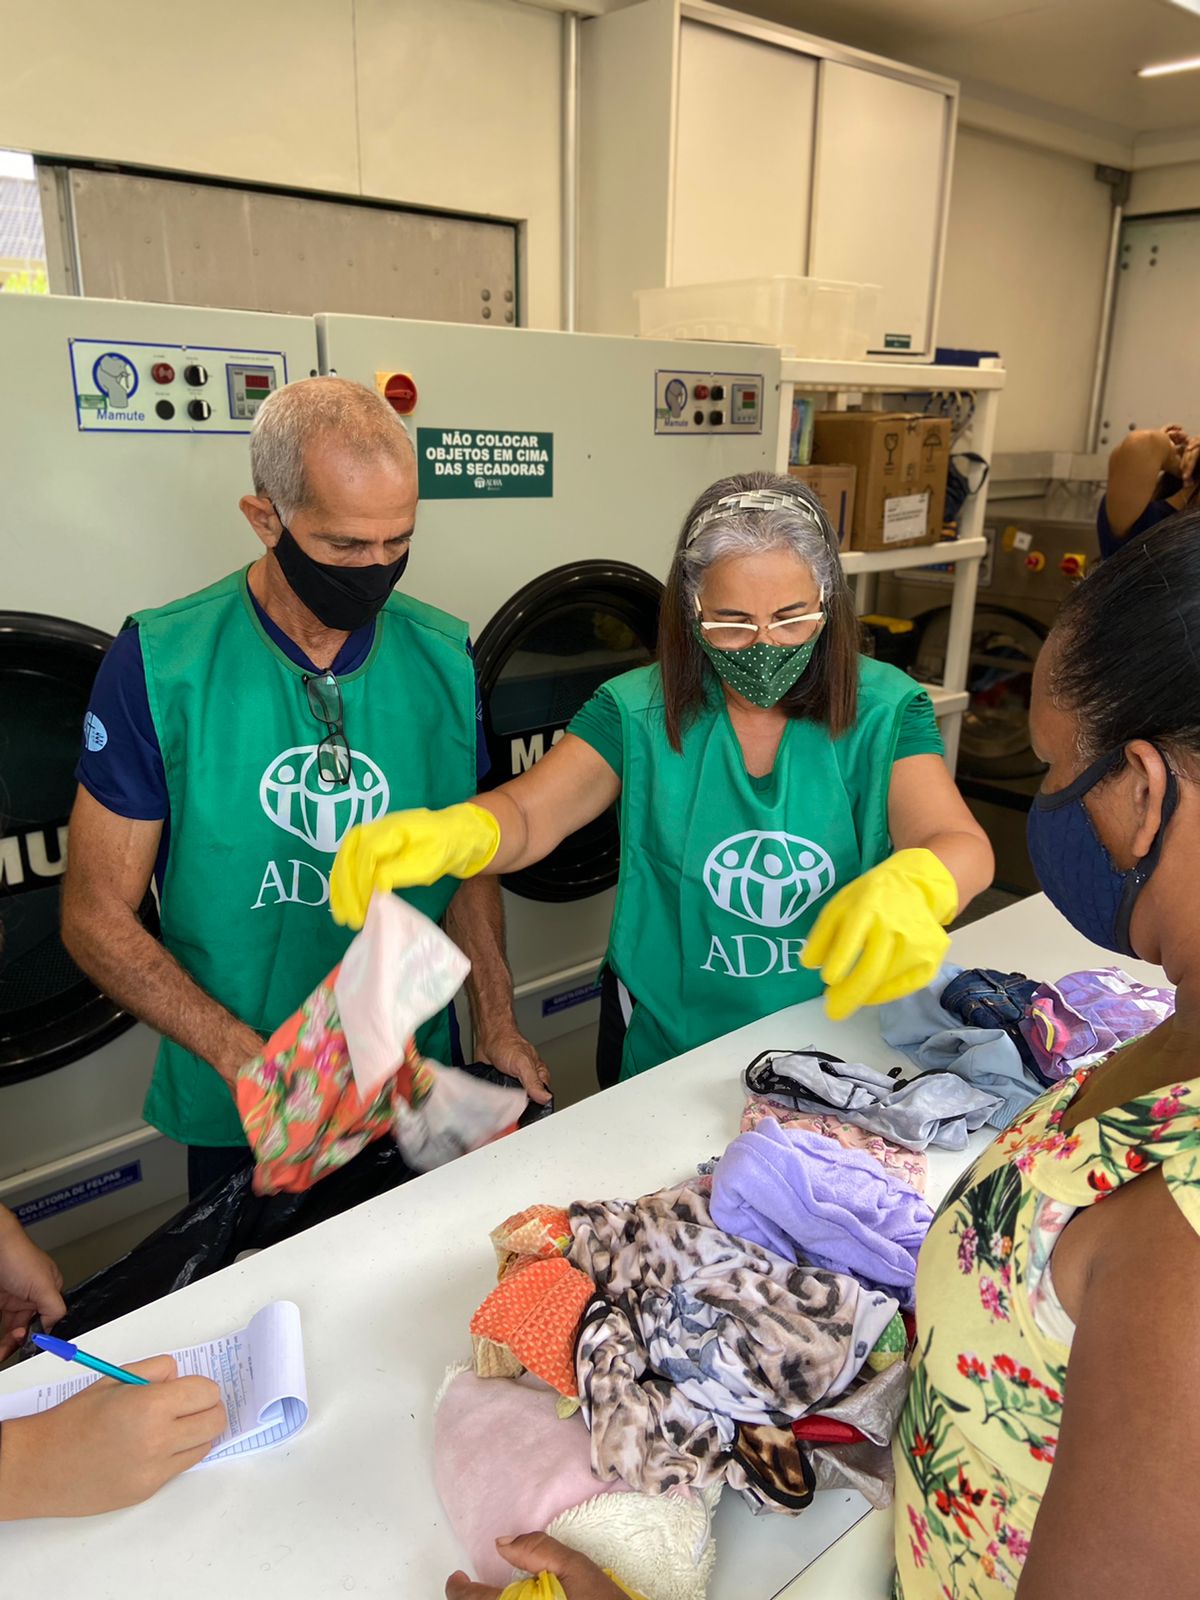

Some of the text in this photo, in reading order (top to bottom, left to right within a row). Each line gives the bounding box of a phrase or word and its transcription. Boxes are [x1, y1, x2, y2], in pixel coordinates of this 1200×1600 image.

[96, 408, 145, 421] Mamute
[441, 431, 538, 447] NÃO COLOCAR
[425, 447, 549, 462] OBJETOS EM CIMA
[435, 462, 545, 476] DAS SECADORAS
[18, 1190, 71, 1216] COLETORA
[71, 1184, 87, 1196] DE
[86, 1171, 122, 1191] FELPAS
